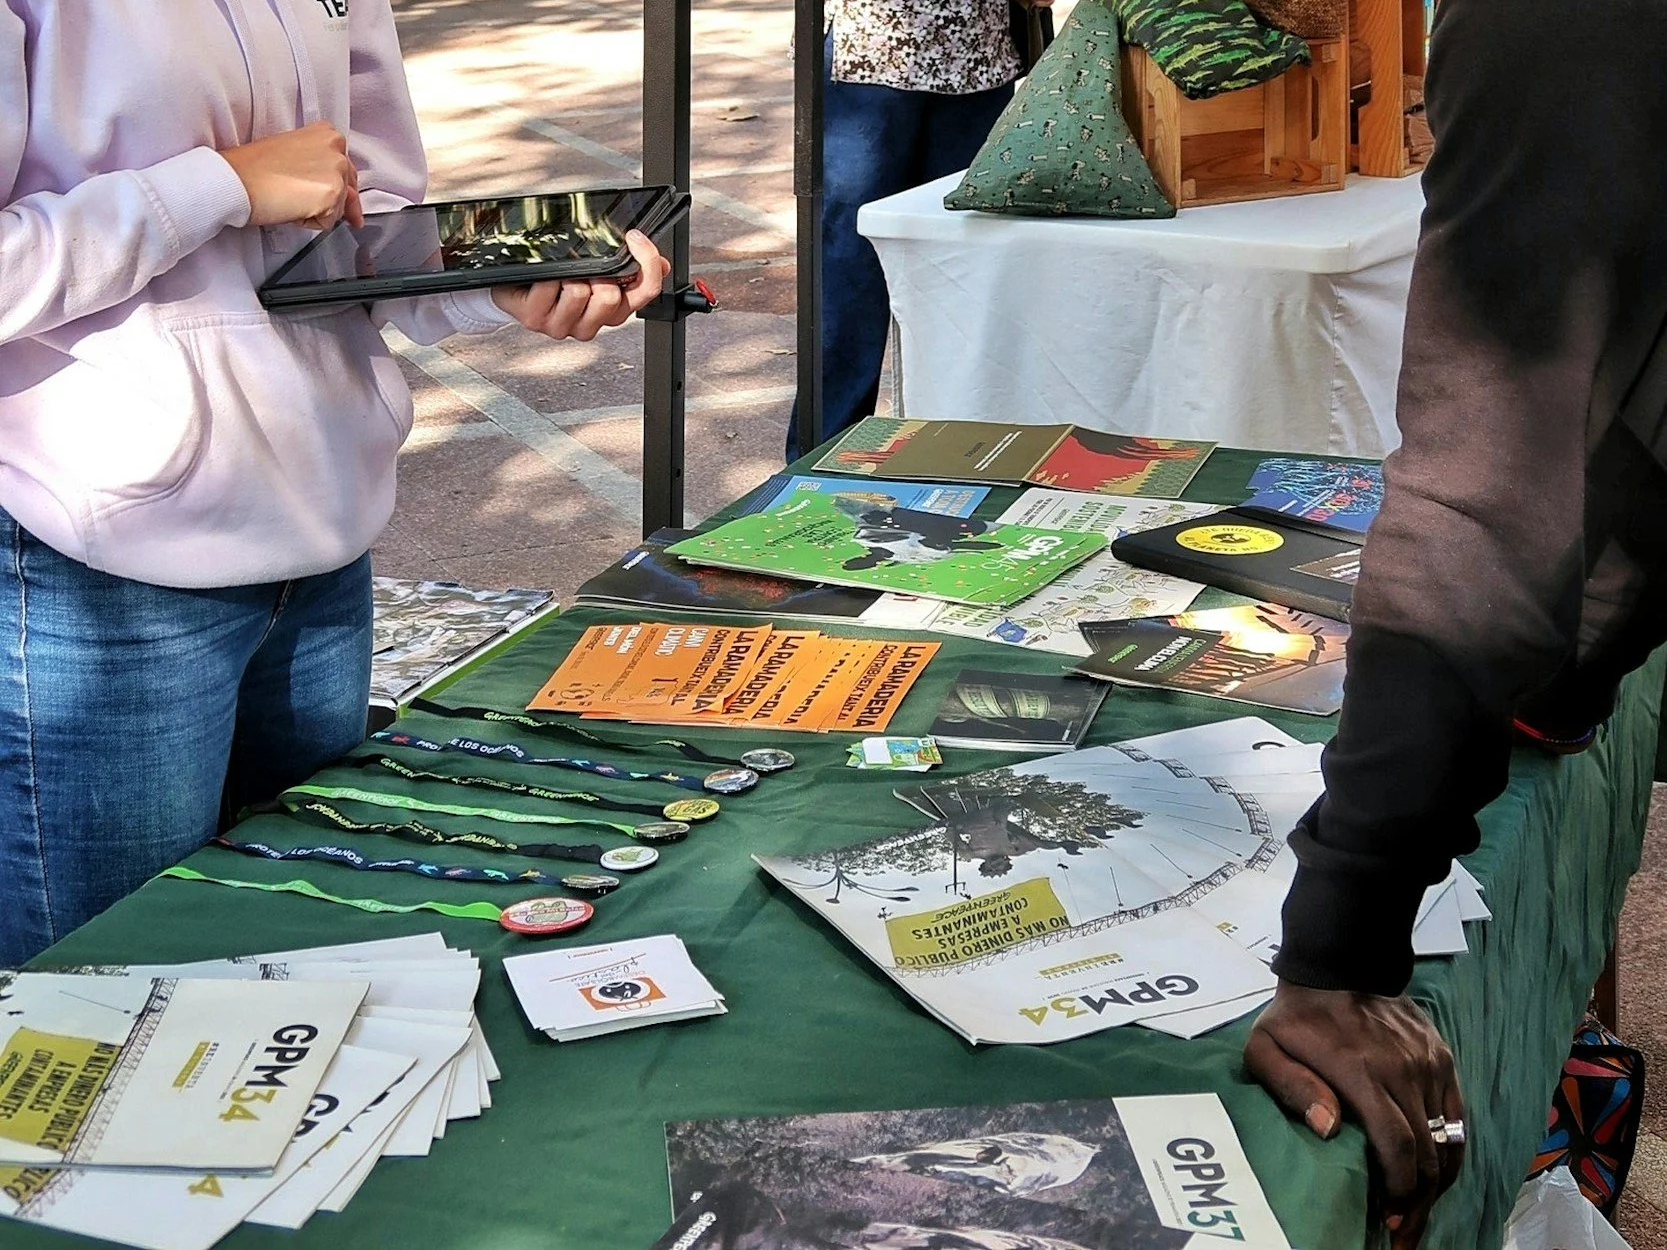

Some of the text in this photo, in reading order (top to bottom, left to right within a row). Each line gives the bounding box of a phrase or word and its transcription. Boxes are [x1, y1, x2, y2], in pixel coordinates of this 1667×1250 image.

[732, 630, 759, 644] LA
[777, 635, 806, 650] LA
[722, 650, 793, 715] RAMADERIA
[852, 645, 926, 728] LA RAMADERIA
[460, 740, 479, 751] LOS
[911, 897, 1029, 940] CONTAMINANTES
[931, 891, 1011, 923] GREENPEACE
[1049, 915, 1070, 929] NO
[937, 914, 1021, 949] A EMPRESAS
[963, 930, 1015, 957] DINERO
[1018, 975, 1199, 1026] GPM34
[28, 1067, 73, 1114] EMPRESAS
[218, 1024, 318, 1122] GPM34
[1166, 1137, 1247, 1242] GPM37
